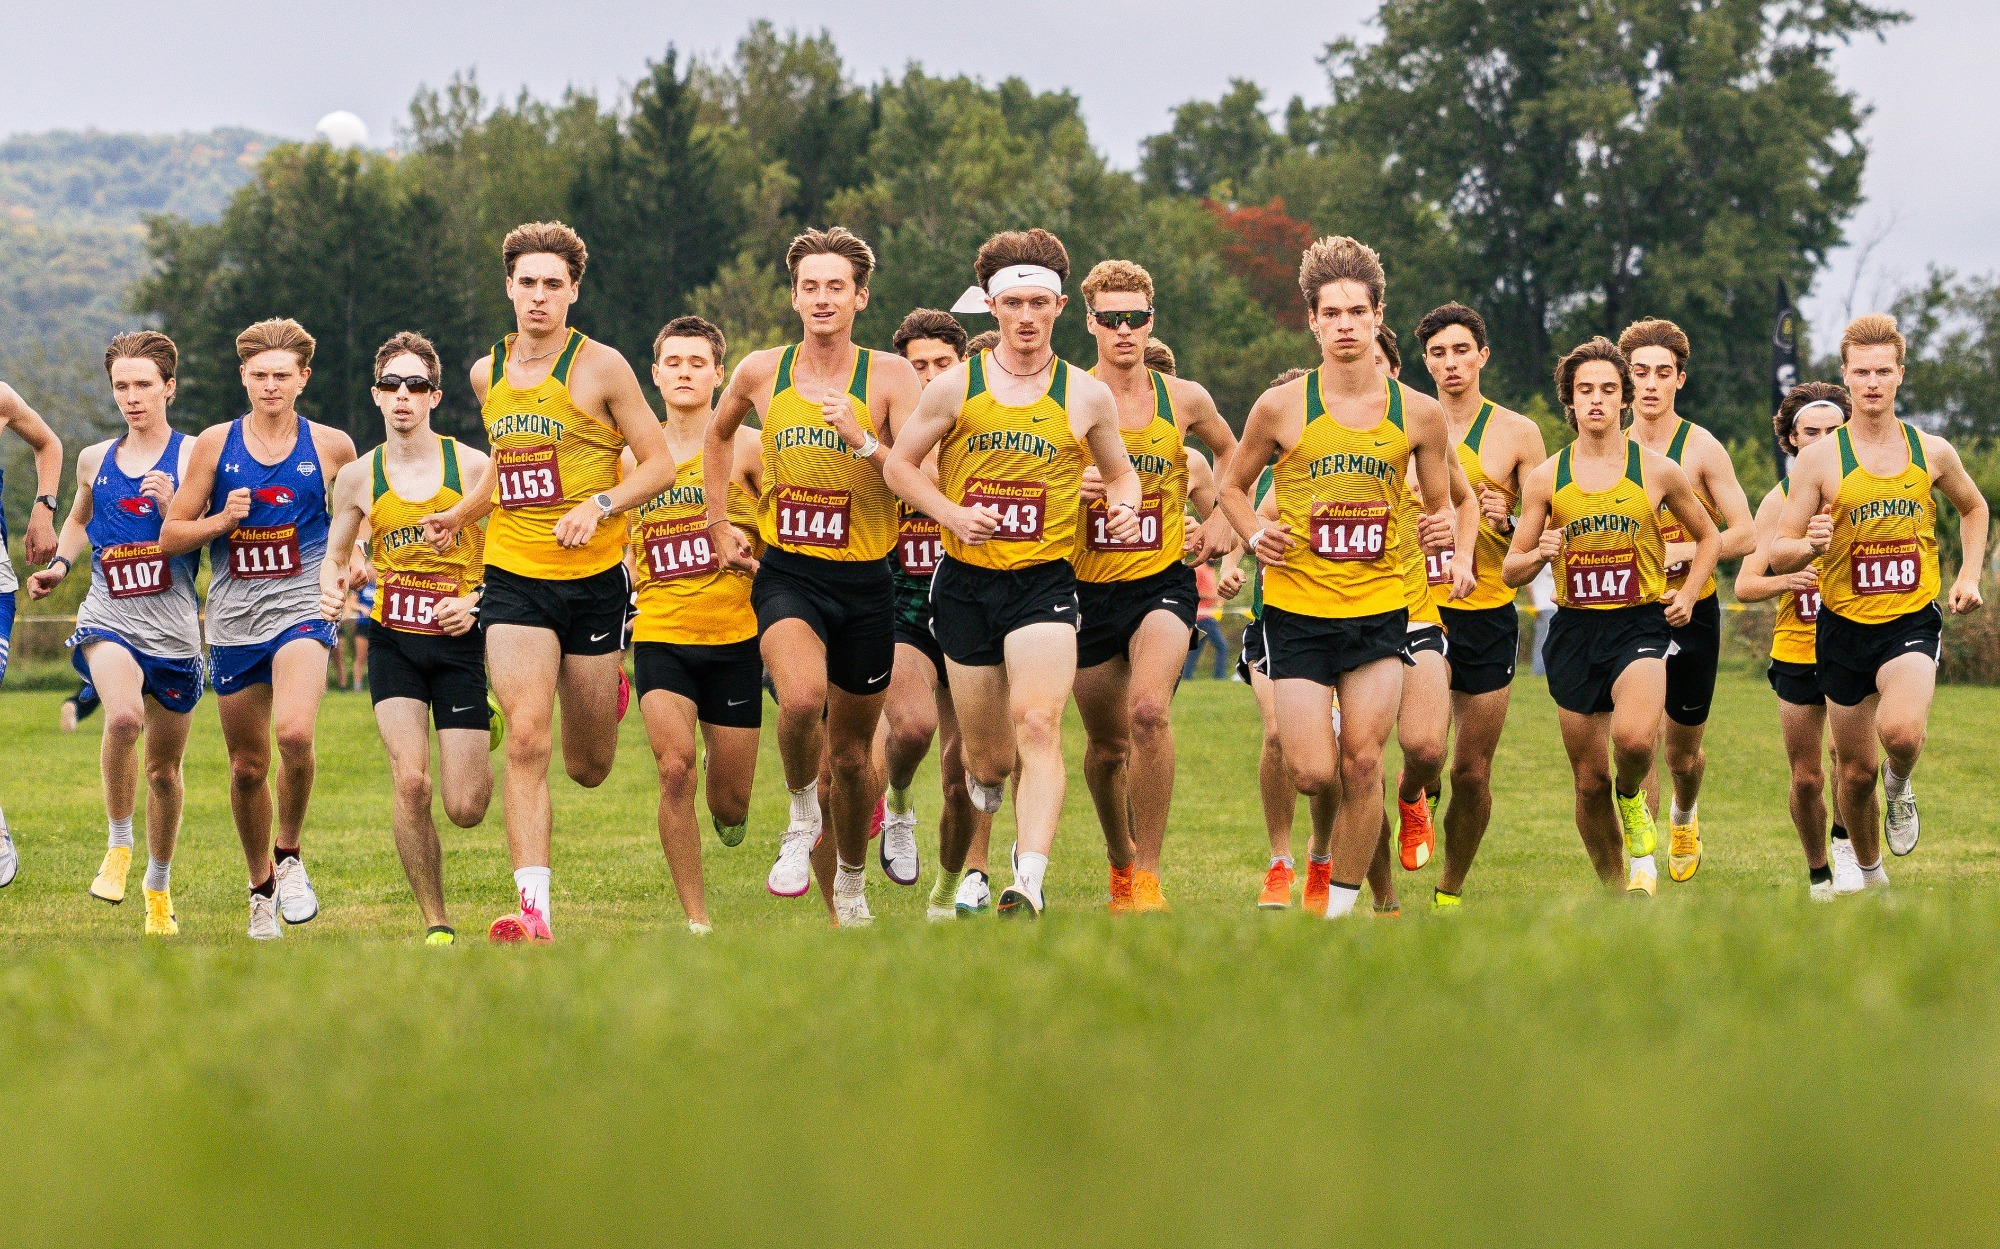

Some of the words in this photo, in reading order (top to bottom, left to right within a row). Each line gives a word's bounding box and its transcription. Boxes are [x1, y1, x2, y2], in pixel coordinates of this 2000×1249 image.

[774, 426, 857, 460] VERMON
[967, 431, 1057, 464] VERMONT
[1129, 454, 1173, 476] MONT
[1309, 454, 1395, 486] VERMONT
[500, 469, 554, 500] 1153
[638, 486, 704, 518] VERMON
[1850, 498, 1924, 527] VERMONT
[780, 508, 843, 540] 1144
[899, 521, 941, 533] Athlet
[1318, 524, 1383, 553] 1146
[1565, 514, 1640, 541] VERMONT
[383, 525, 463, 553] VERMT
[904, 540, 946, 567] 115
[236, 545, 293, 571] 1111
[652, 537, 711, 572] 1149
[109, 560, 163, 591] 1107
[1573, 569, 1631, 598] 1147
[1857, 560, 1915, 588] 1148
[388, 592, 438, 625] 115
